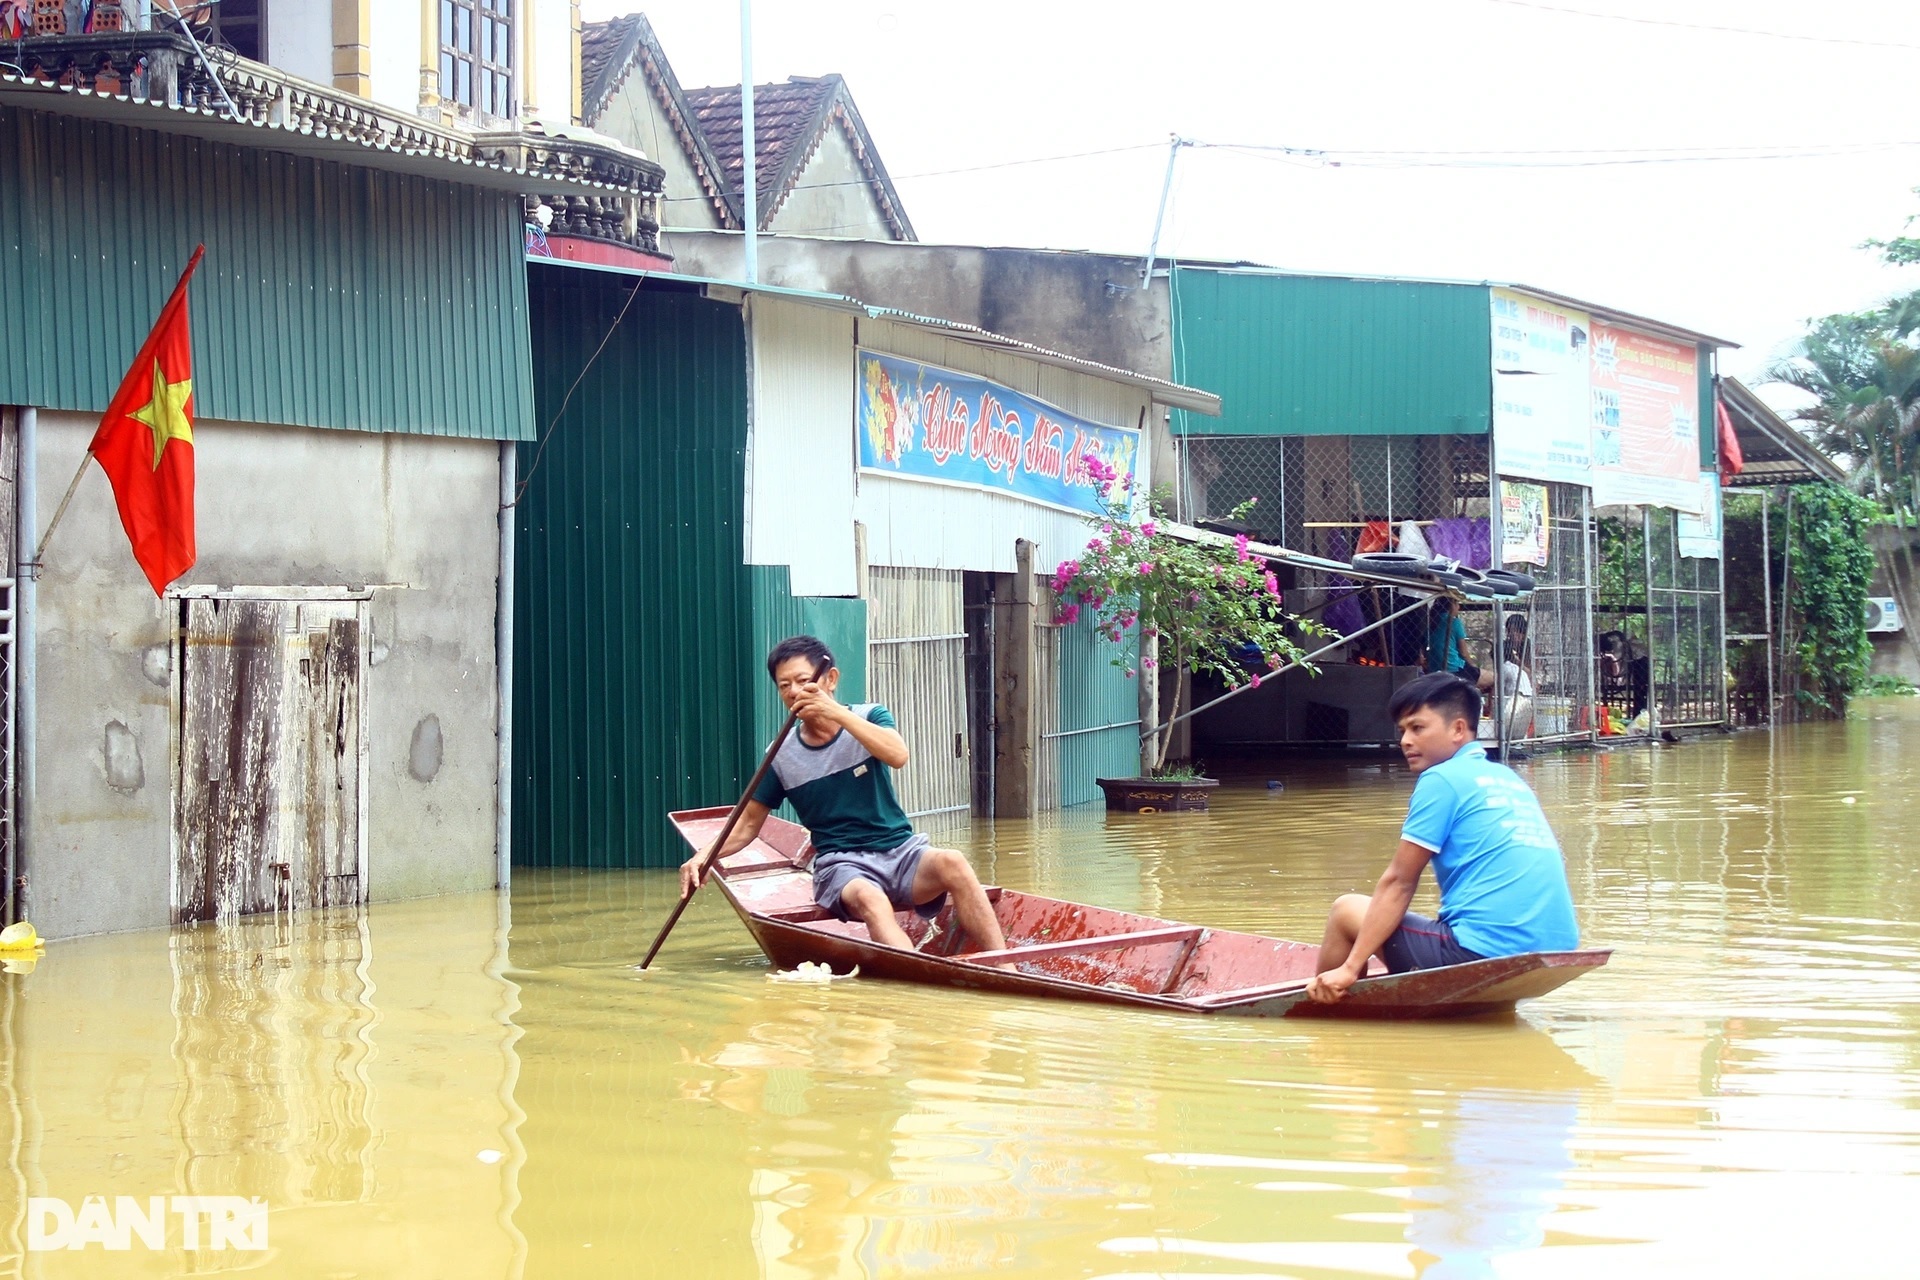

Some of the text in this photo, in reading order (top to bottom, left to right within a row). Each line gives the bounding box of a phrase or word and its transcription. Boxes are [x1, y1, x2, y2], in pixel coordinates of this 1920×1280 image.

[923, 383, 969, 466] Chúc
[970, 391, 1022, 485] Mừng
[1024, 413, 1064, 479] Năm
